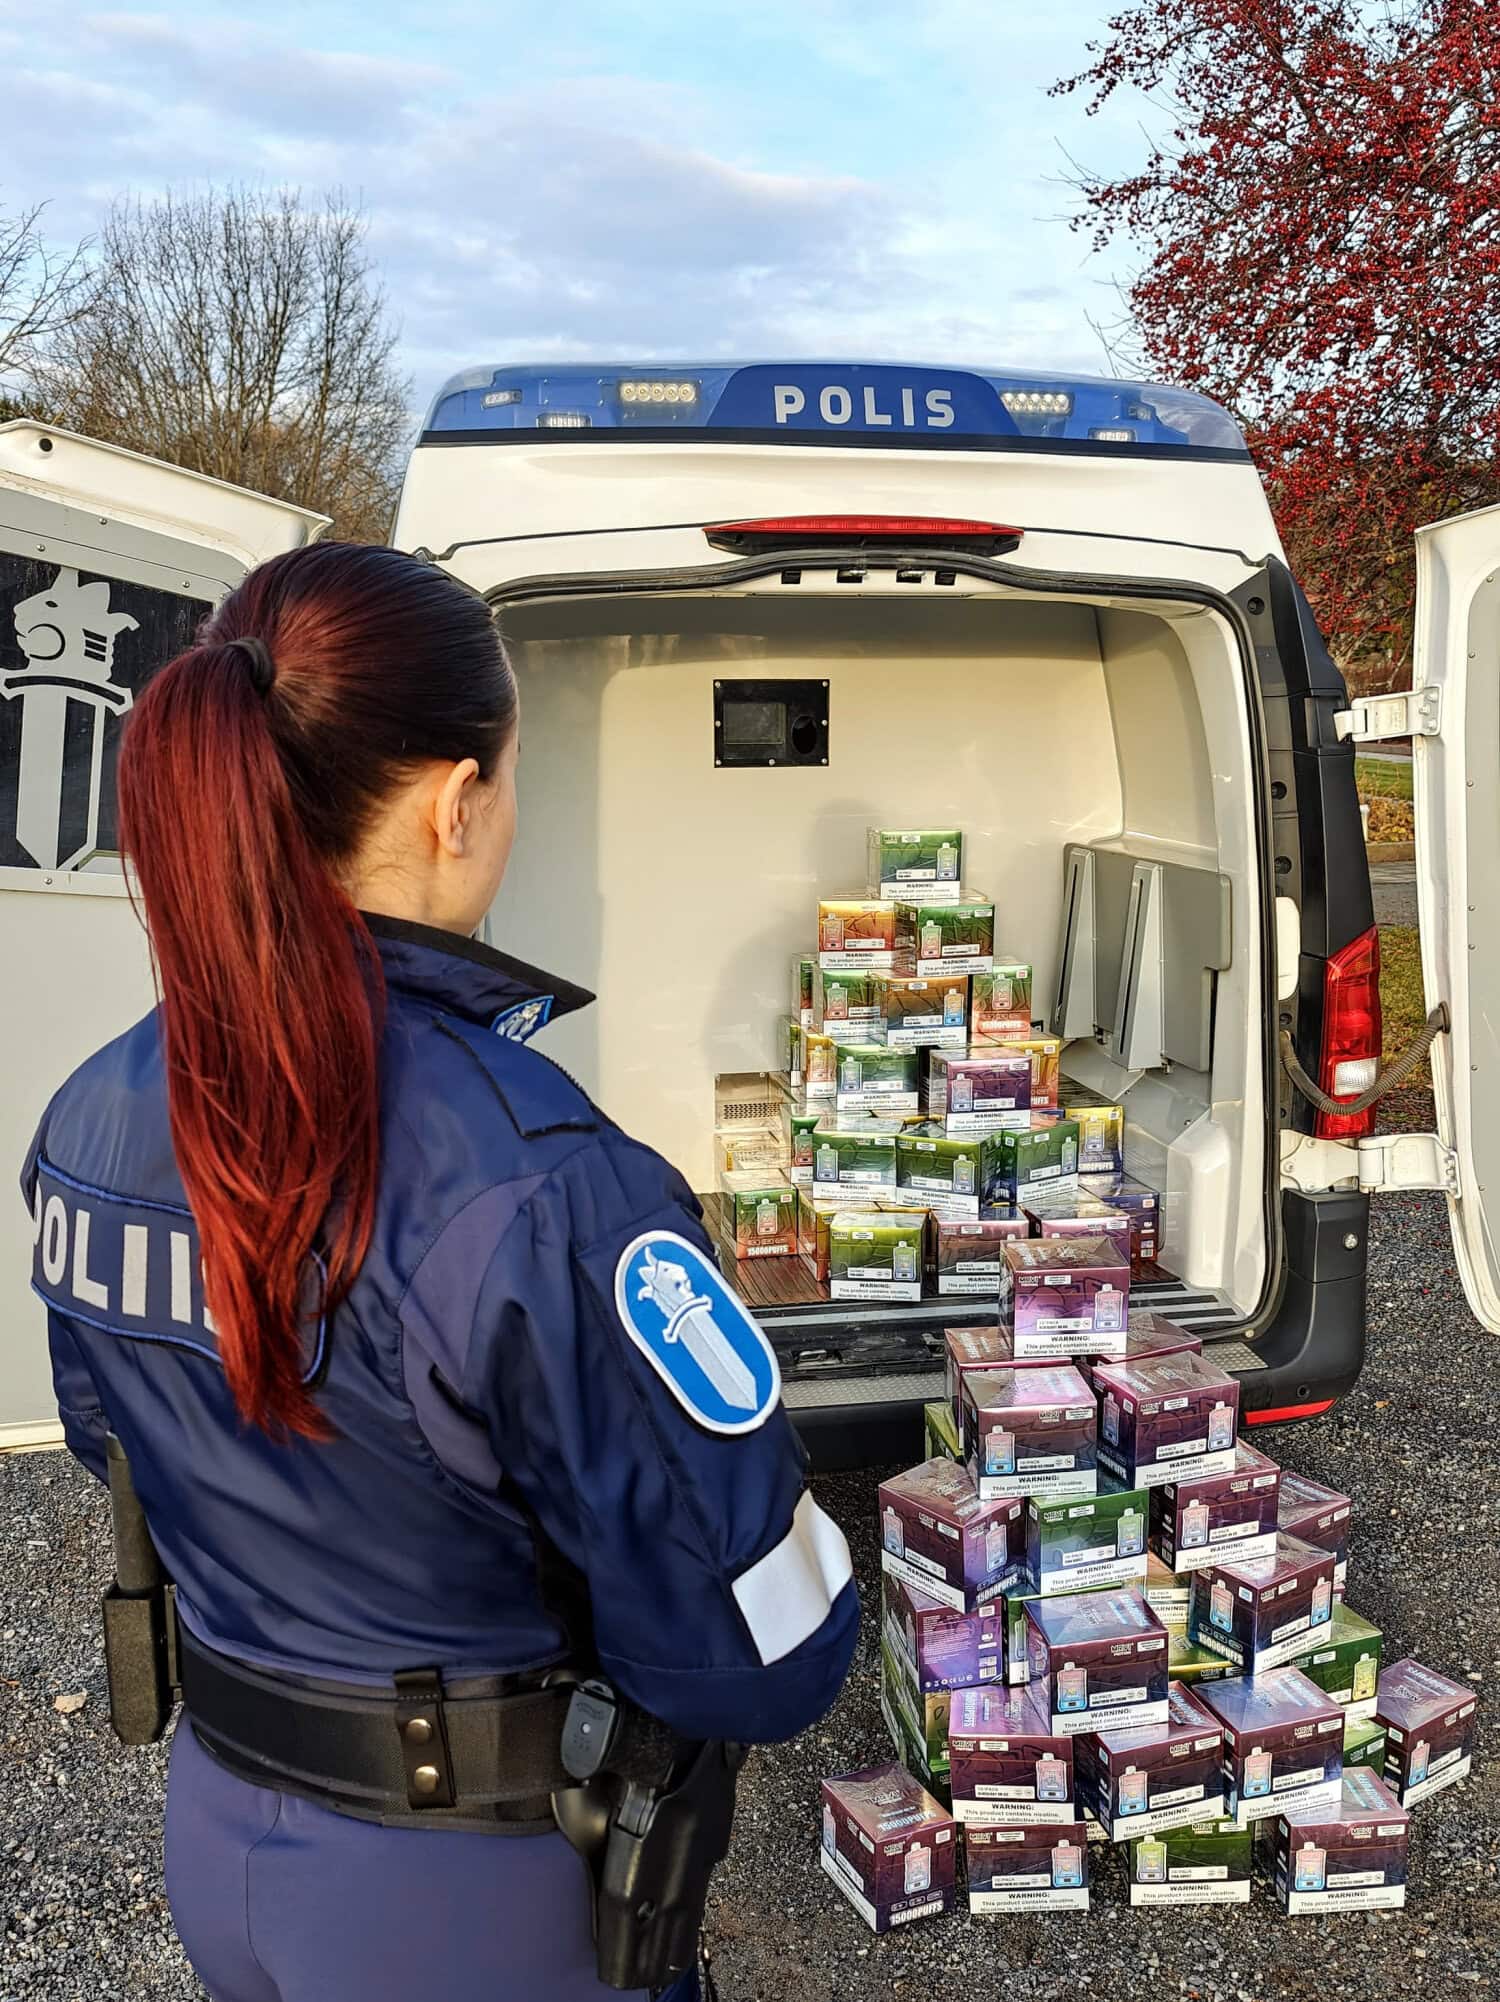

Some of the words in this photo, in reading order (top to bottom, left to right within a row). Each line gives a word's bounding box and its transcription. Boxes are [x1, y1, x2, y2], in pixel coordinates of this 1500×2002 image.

[774, 385, 955, 428] POLIS
[1018, 1475, 1060, 1484] WARNING:
[1091, 1707, 1131, 1718] WARNING:
[1150, 1807, 1190, 1819] WARNING:
[888, 1899, 945, 1927] 15000PUFFS
